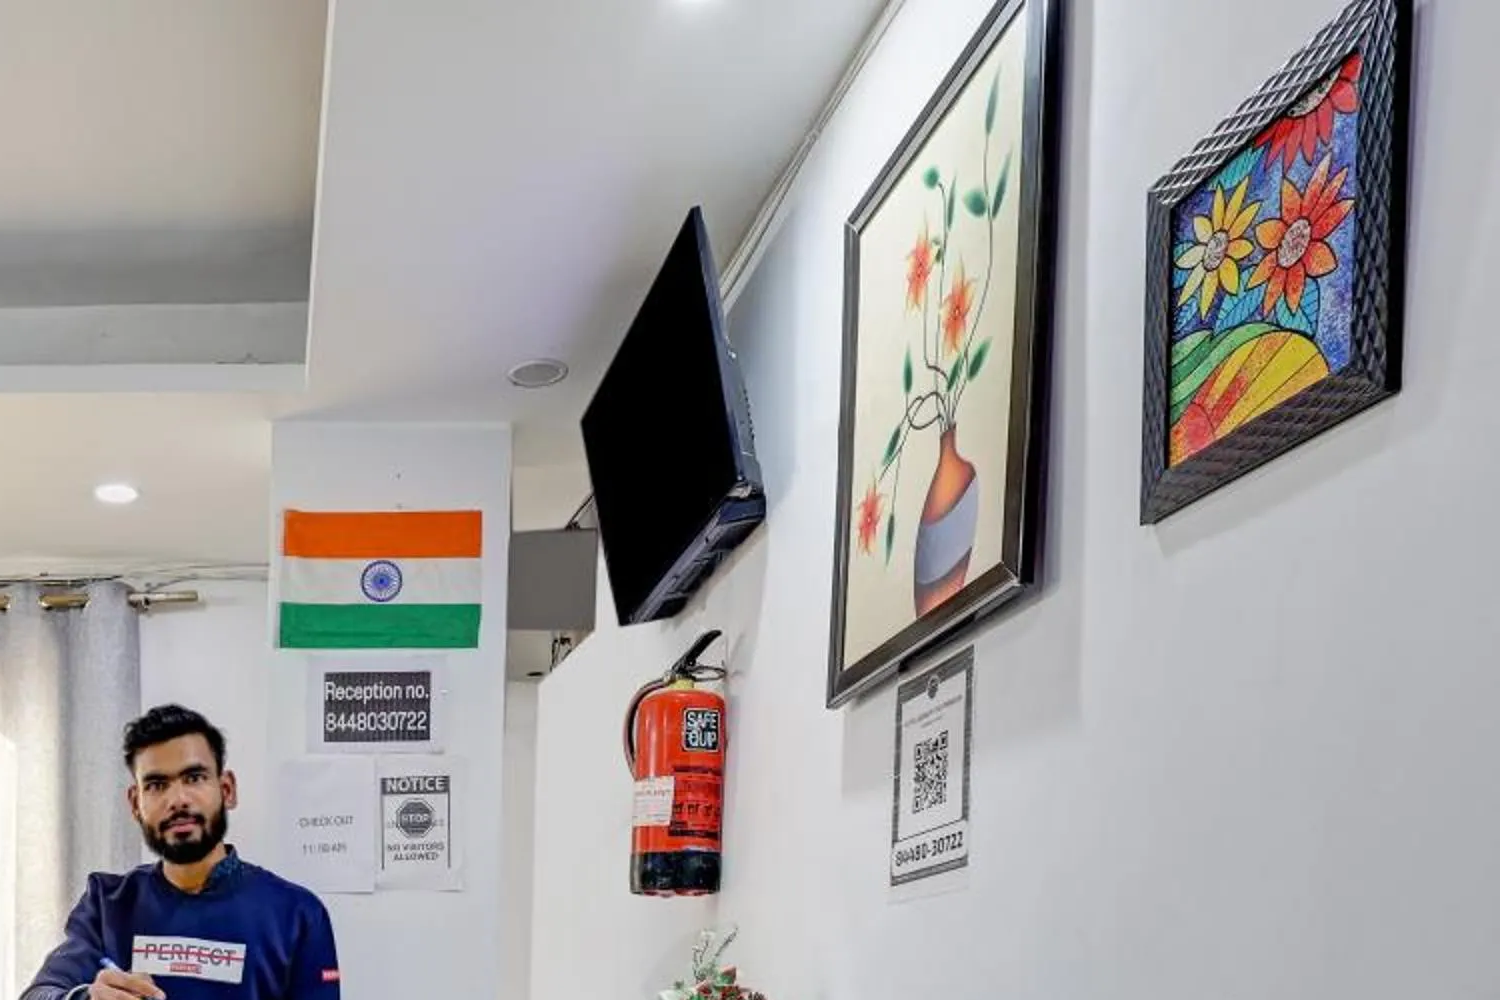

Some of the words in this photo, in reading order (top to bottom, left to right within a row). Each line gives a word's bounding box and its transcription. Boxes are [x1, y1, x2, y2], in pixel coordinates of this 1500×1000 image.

[325, 681, 403, 705] Reception
[405, 685, 430, 700] no.
[325, 711, 428, 732] 8448030722
[687, 711, 717, 729] SAFE
[386, 777, 445, 793] NOTICE
[144, 943, 237, 967] PERFECT
